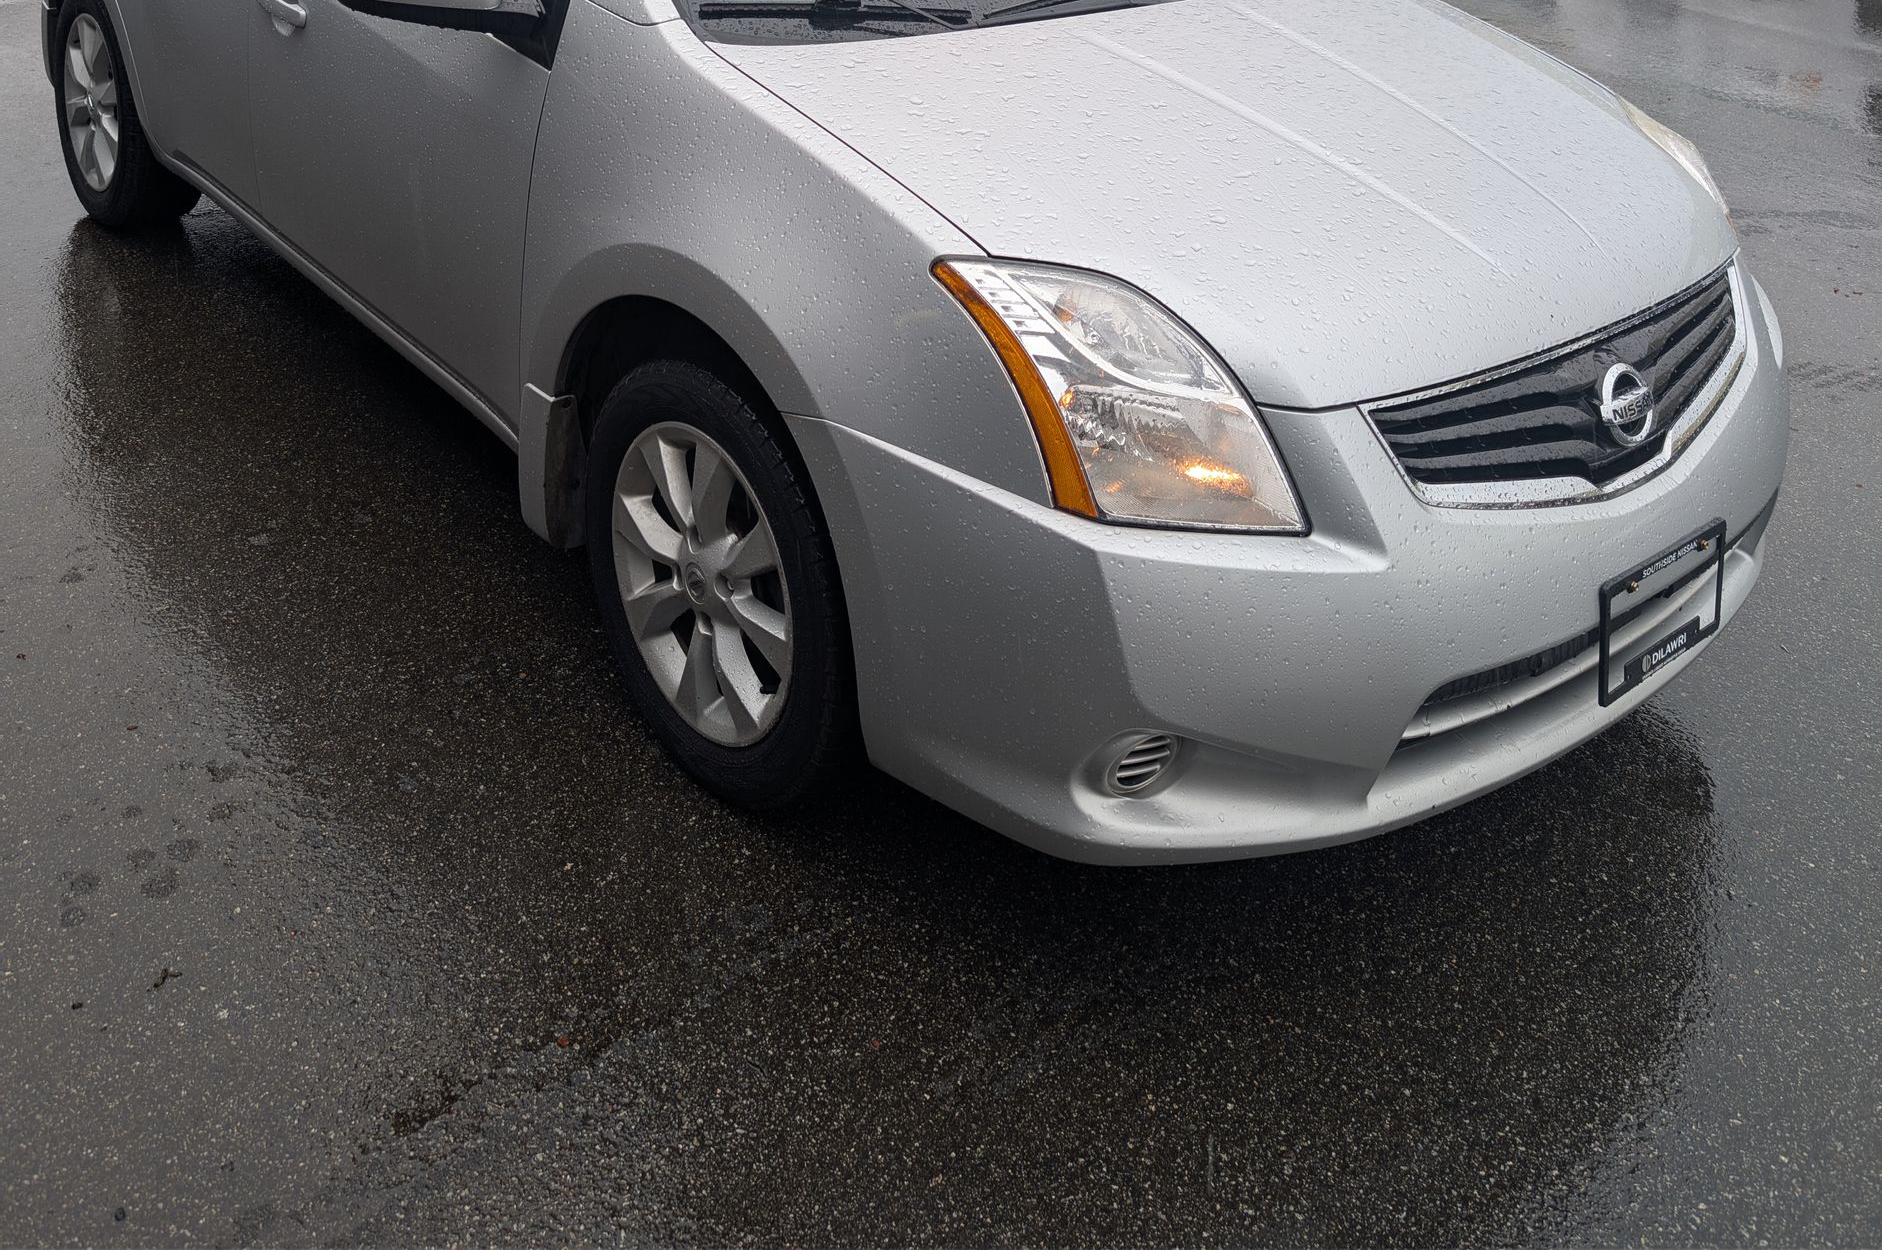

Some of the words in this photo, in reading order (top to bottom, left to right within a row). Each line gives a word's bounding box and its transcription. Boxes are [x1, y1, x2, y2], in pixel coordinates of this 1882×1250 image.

[1612, 393, 1653, 421] NISSAN
[1642, 552, 1677, 578] SOUTHSIDE
[1677, 539, 1698, 558] NISSAN
[1652, 632, 1687, 665] DILAWRI
